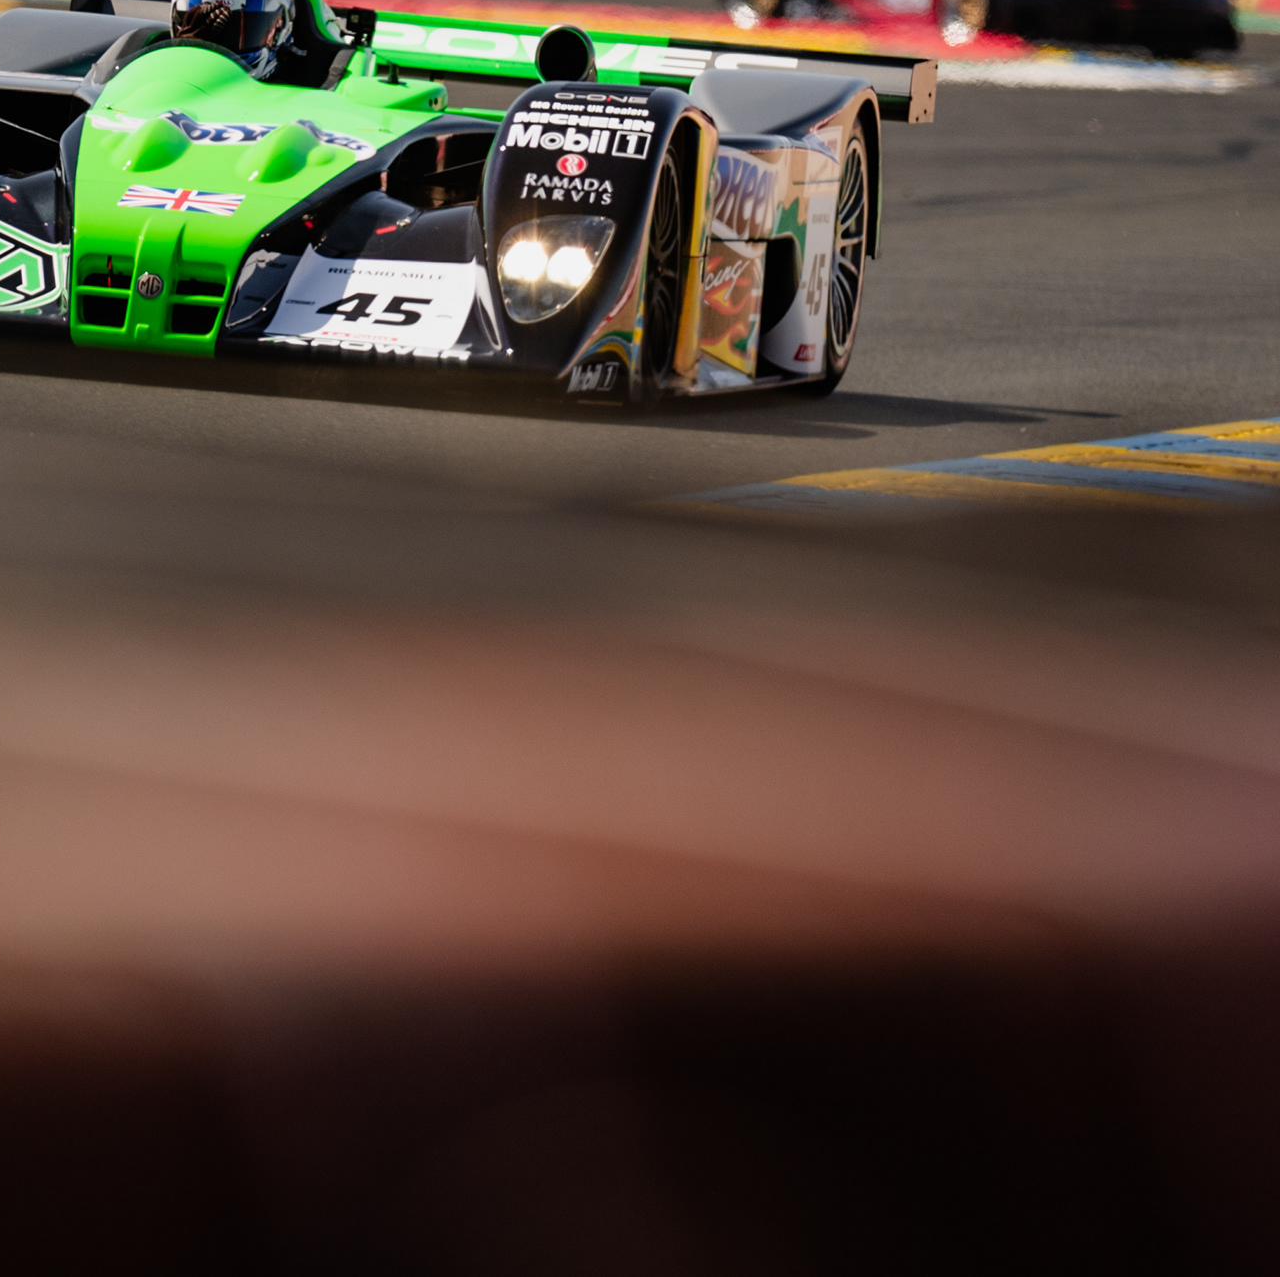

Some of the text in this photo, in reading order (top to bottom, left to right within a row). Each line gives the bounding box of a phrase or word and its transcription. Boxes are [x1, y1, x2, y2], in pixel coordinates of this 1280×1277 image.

[530, 101, 649, 116] MG Rover UK Dealers
[513, 111, 655, 133] MICHELIN
[506, 124, 611, 154] Mobil
[524, 173, 613, 192] RAMADA
[520, 186, 612, 205] JARVIS
[328, 267, 395, 277] RICHARD
[139, 275, 162, 296] MG
[316, 292, 433, 326] 45
